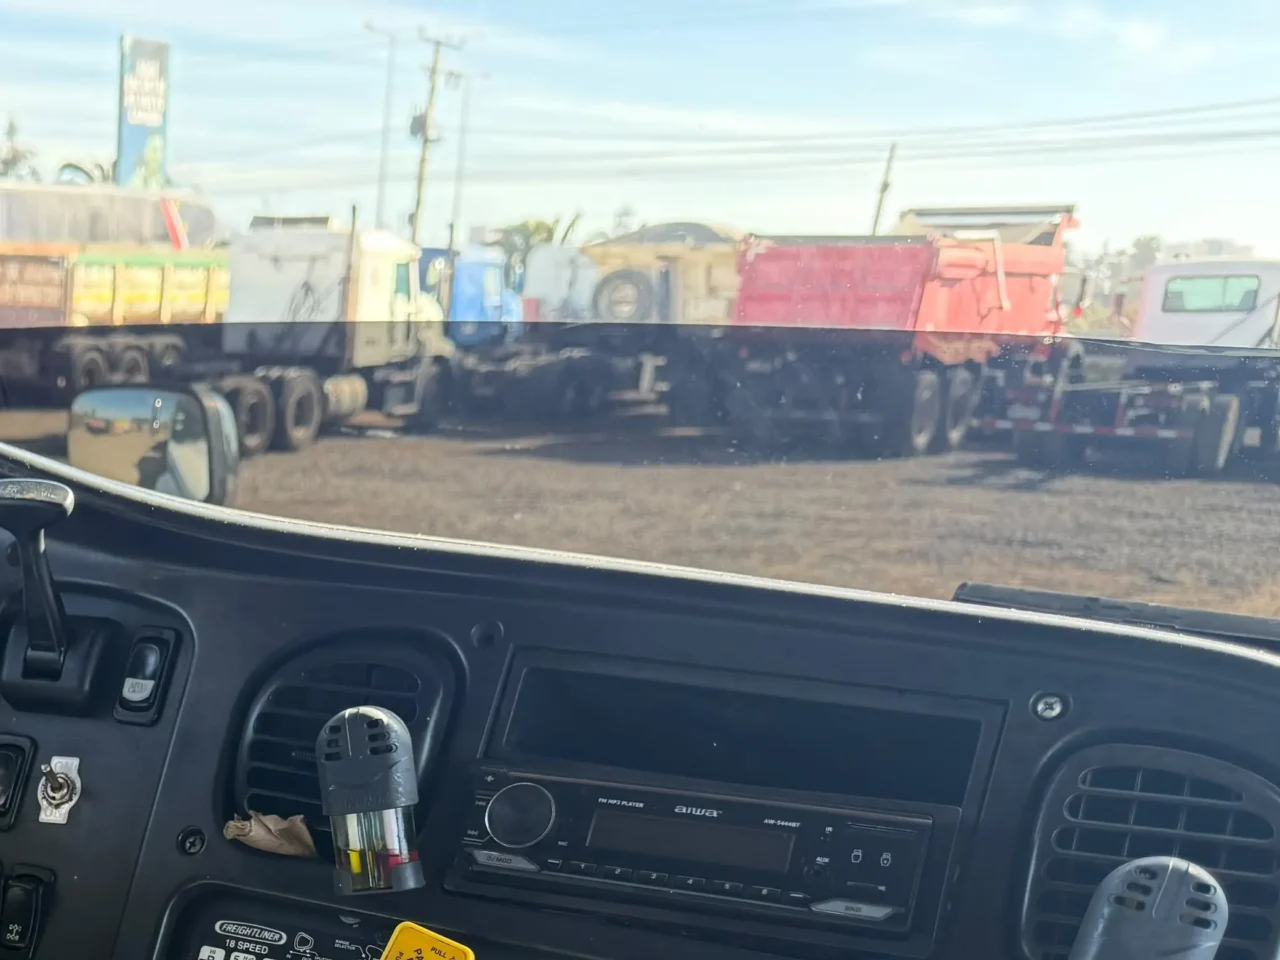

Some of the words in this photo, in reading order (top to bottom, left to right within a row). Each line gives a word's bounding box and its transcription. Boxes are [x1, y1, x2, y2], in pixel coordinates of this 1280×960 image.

[608, 798, 621, 806] MP3
[621, 800, 645, 808] PLAYER
[674, 805, 719, 818] aiwa
[221, 923, 281, 941] FREIGHTLINER
[225, 939, 235, 948] 18
[237, 941, 269, 954] SPEED
[430, 946, 447, 959] PULL
